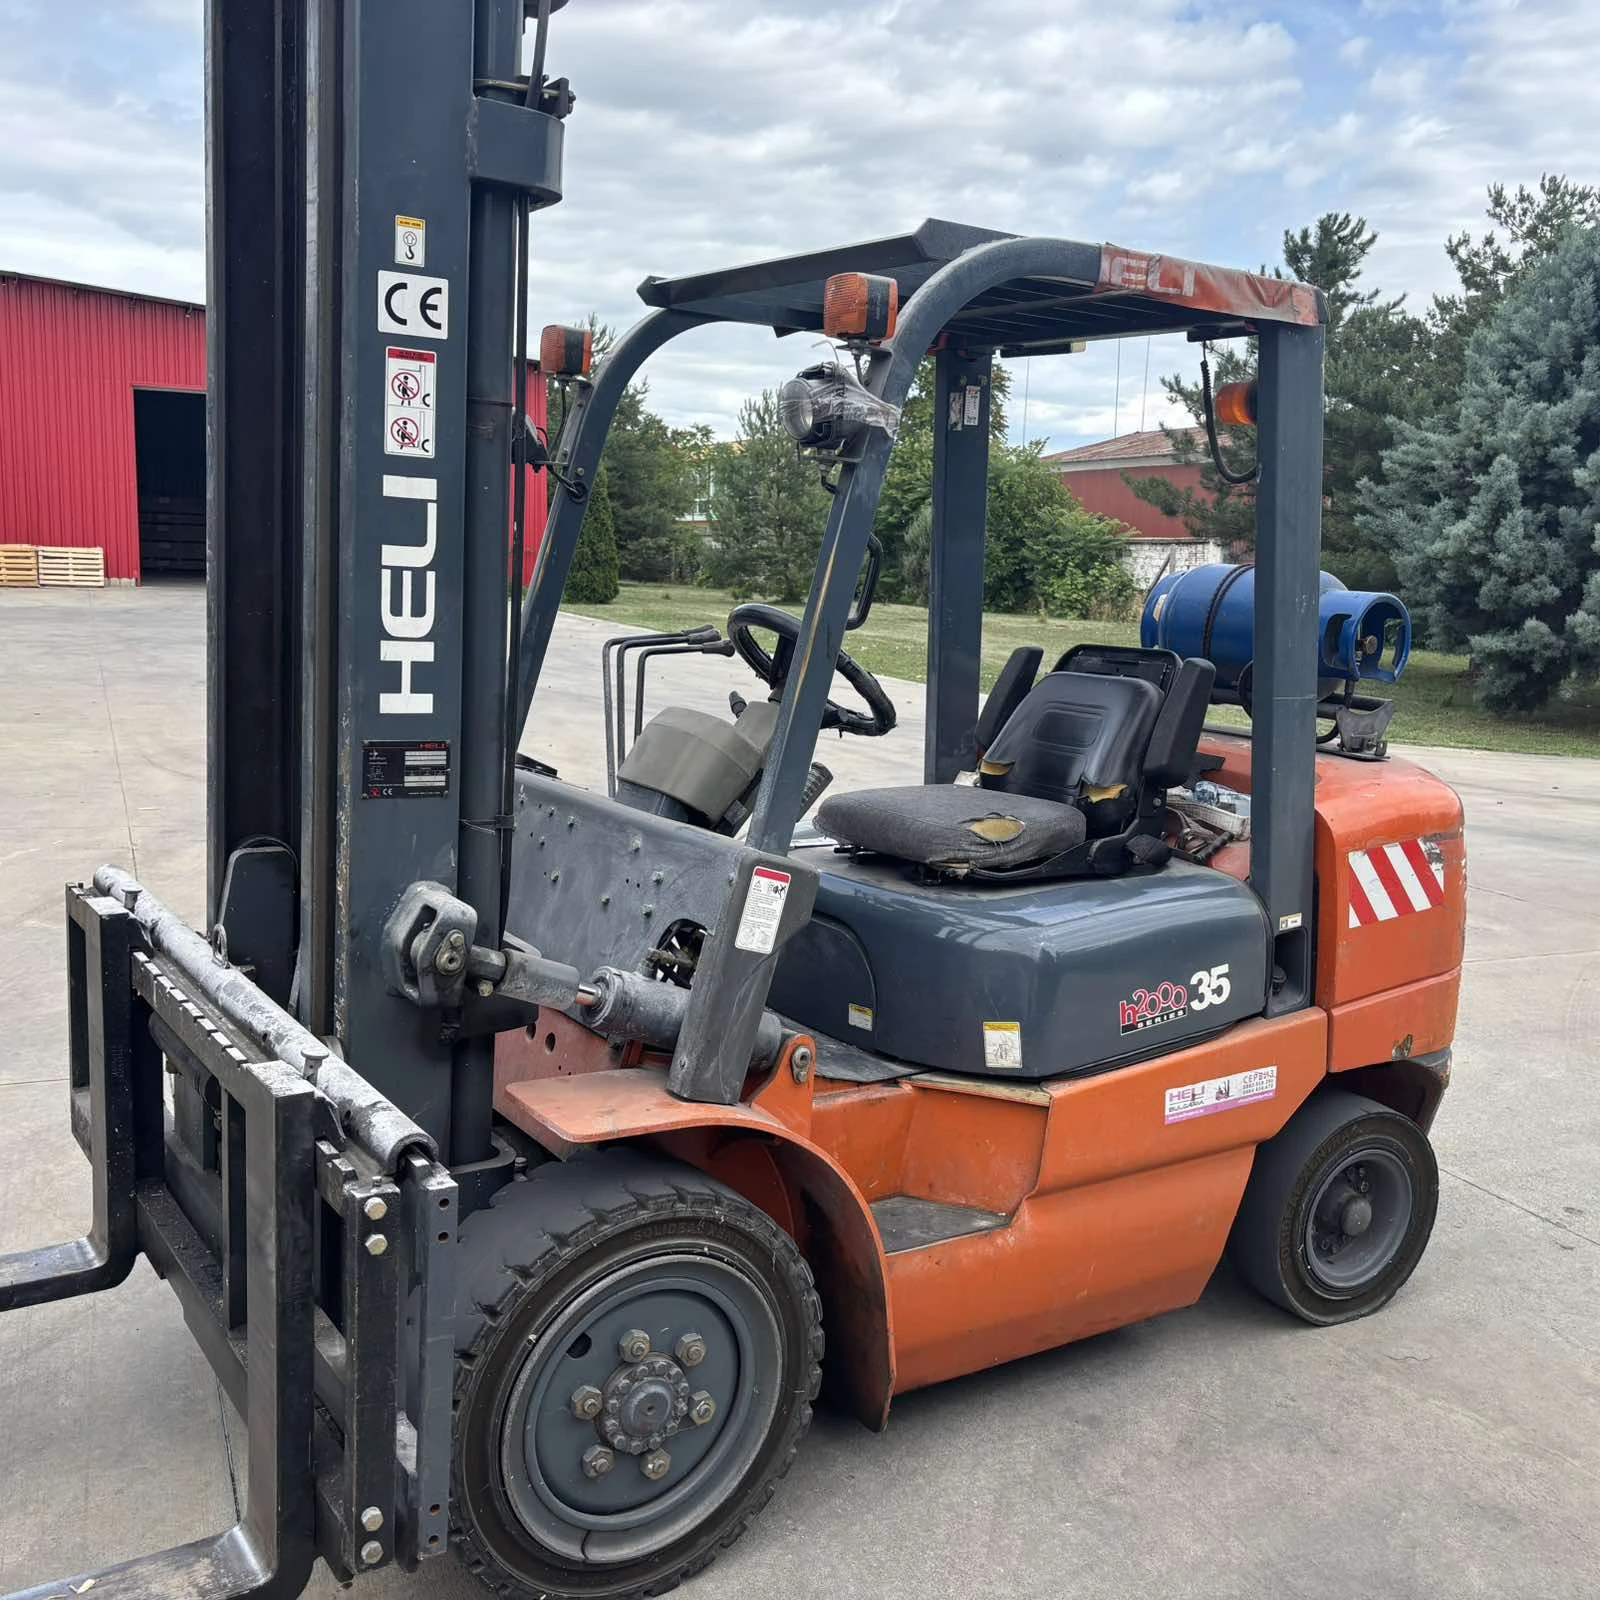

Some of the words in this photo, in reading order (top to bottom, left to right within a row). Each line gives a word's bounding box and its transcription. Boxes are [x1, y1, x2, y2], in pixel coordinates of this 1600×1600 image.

[384, 282, 442, 330] CE
[379, 475, 437, 714] HELI
[1120, 981, 1188, 1026] h2000
[1190, 963, 1231, 1011] 35
[1137, 1009, 1184, 1029] SERIES
[1168, 1085, 1205, 1102] HELI
[1168, 1101, 1205, 1113] BULGARIA
